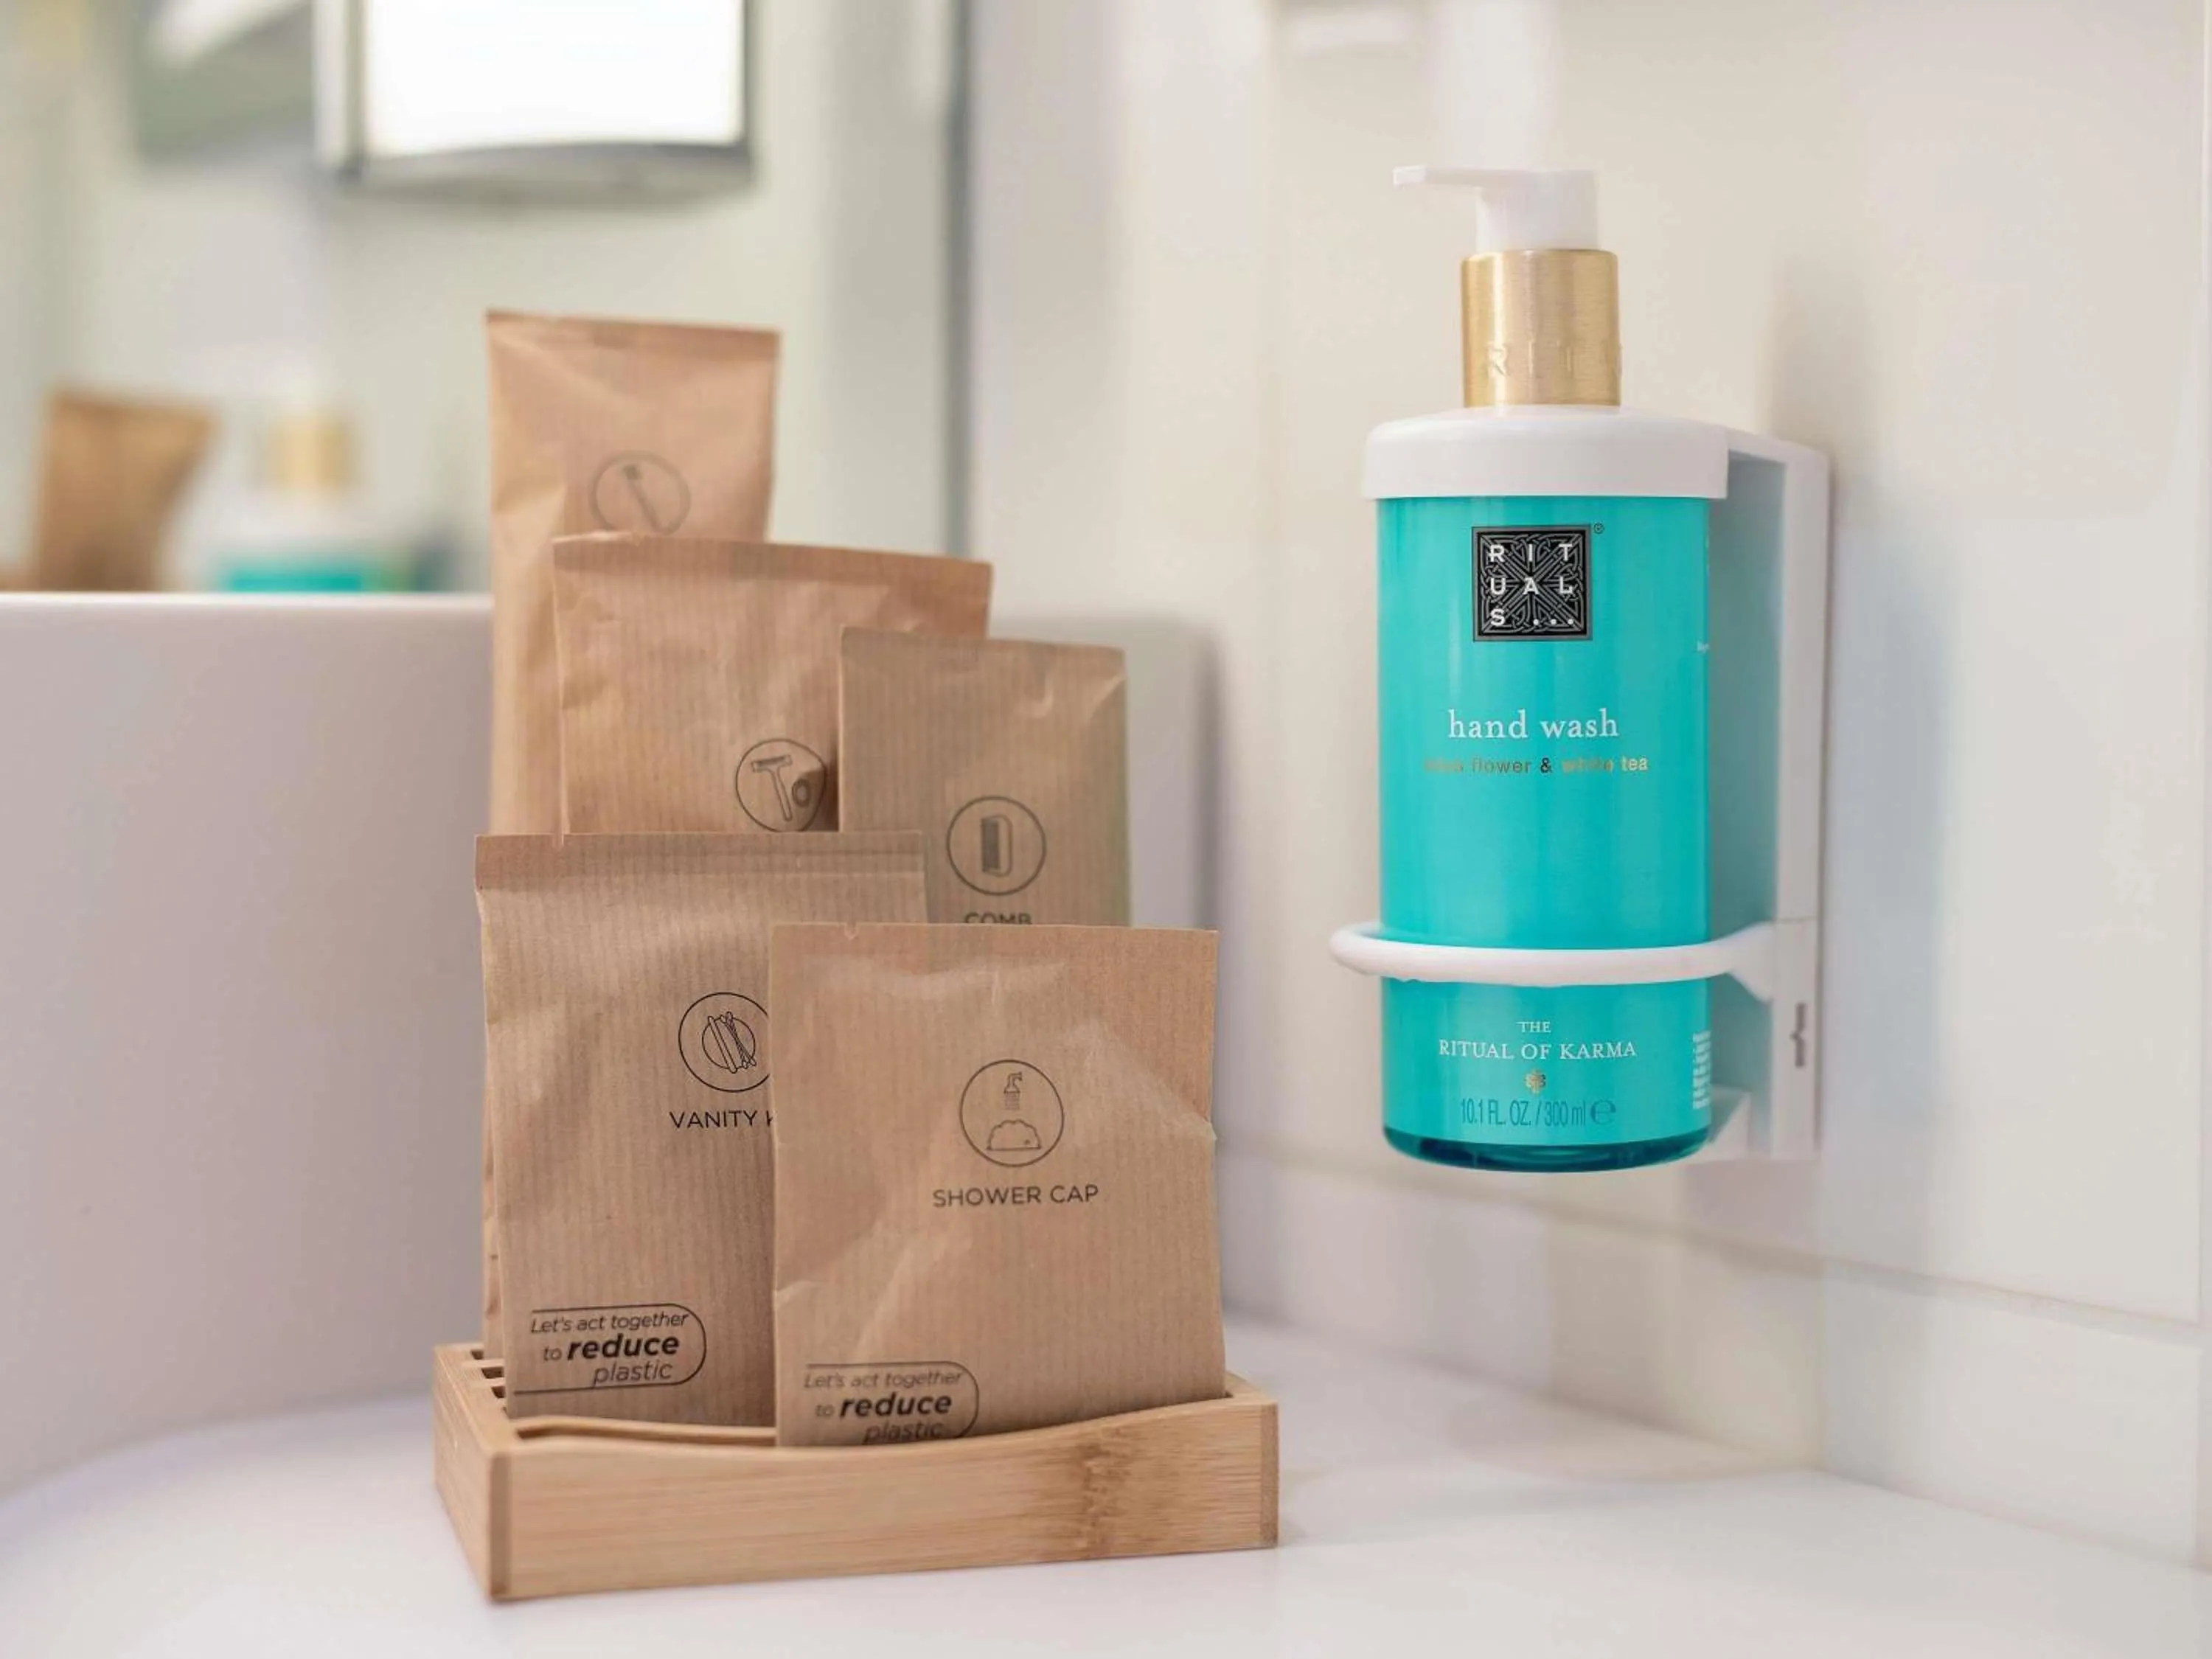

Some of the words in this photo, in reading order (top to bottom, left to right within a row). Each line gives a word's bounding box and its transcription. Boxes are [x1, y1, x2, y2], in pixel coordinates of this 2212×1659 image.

[1448, 708, 1528, 739] hand
[1540, 707, 1620, 739] wash
[1540, 757, 1553, 774] &
[1621, 755, 1649, 772] tea
[1517, 1020, 1551, 1034] THE
[1439, 1039, 1515, 1060] RITUAL
[1520, 1043, 1552, 1060] OF
[1559, 1040, 1638, 1060] KARMA
[669, 1109, 758, 1129] VANITY
[1461, 1098, 1484, 1125] 10.1
[1509, 1099, 1532, 1127] OZ.
[1544, 1100, 1569, 1127] 300
[1571, 1099, 1586, 1127] ml
[932, 1186, 1042, 1208] SHOWER
[1049, 1183, 1099, 1205] CAP
[530, 1317, 574, 1335] Let's
[577, 1315, 606, 1332] act
[611, 1310, 689, 1332] together
[542, 1346, 563, 1362] to
[567, 1332, 680, 1361] reduce
[592, 1359, 673, 1389] plastic
[803, 1372, 846, 1389] Let's
[851, 1373, 880, 1388] act
[885, 1369, 962, 1389] together
[814, 1403, 835, 1419] to
[839, 1391, 953, 1419] reduce
[861, 1420, 945, 1445] plastic
